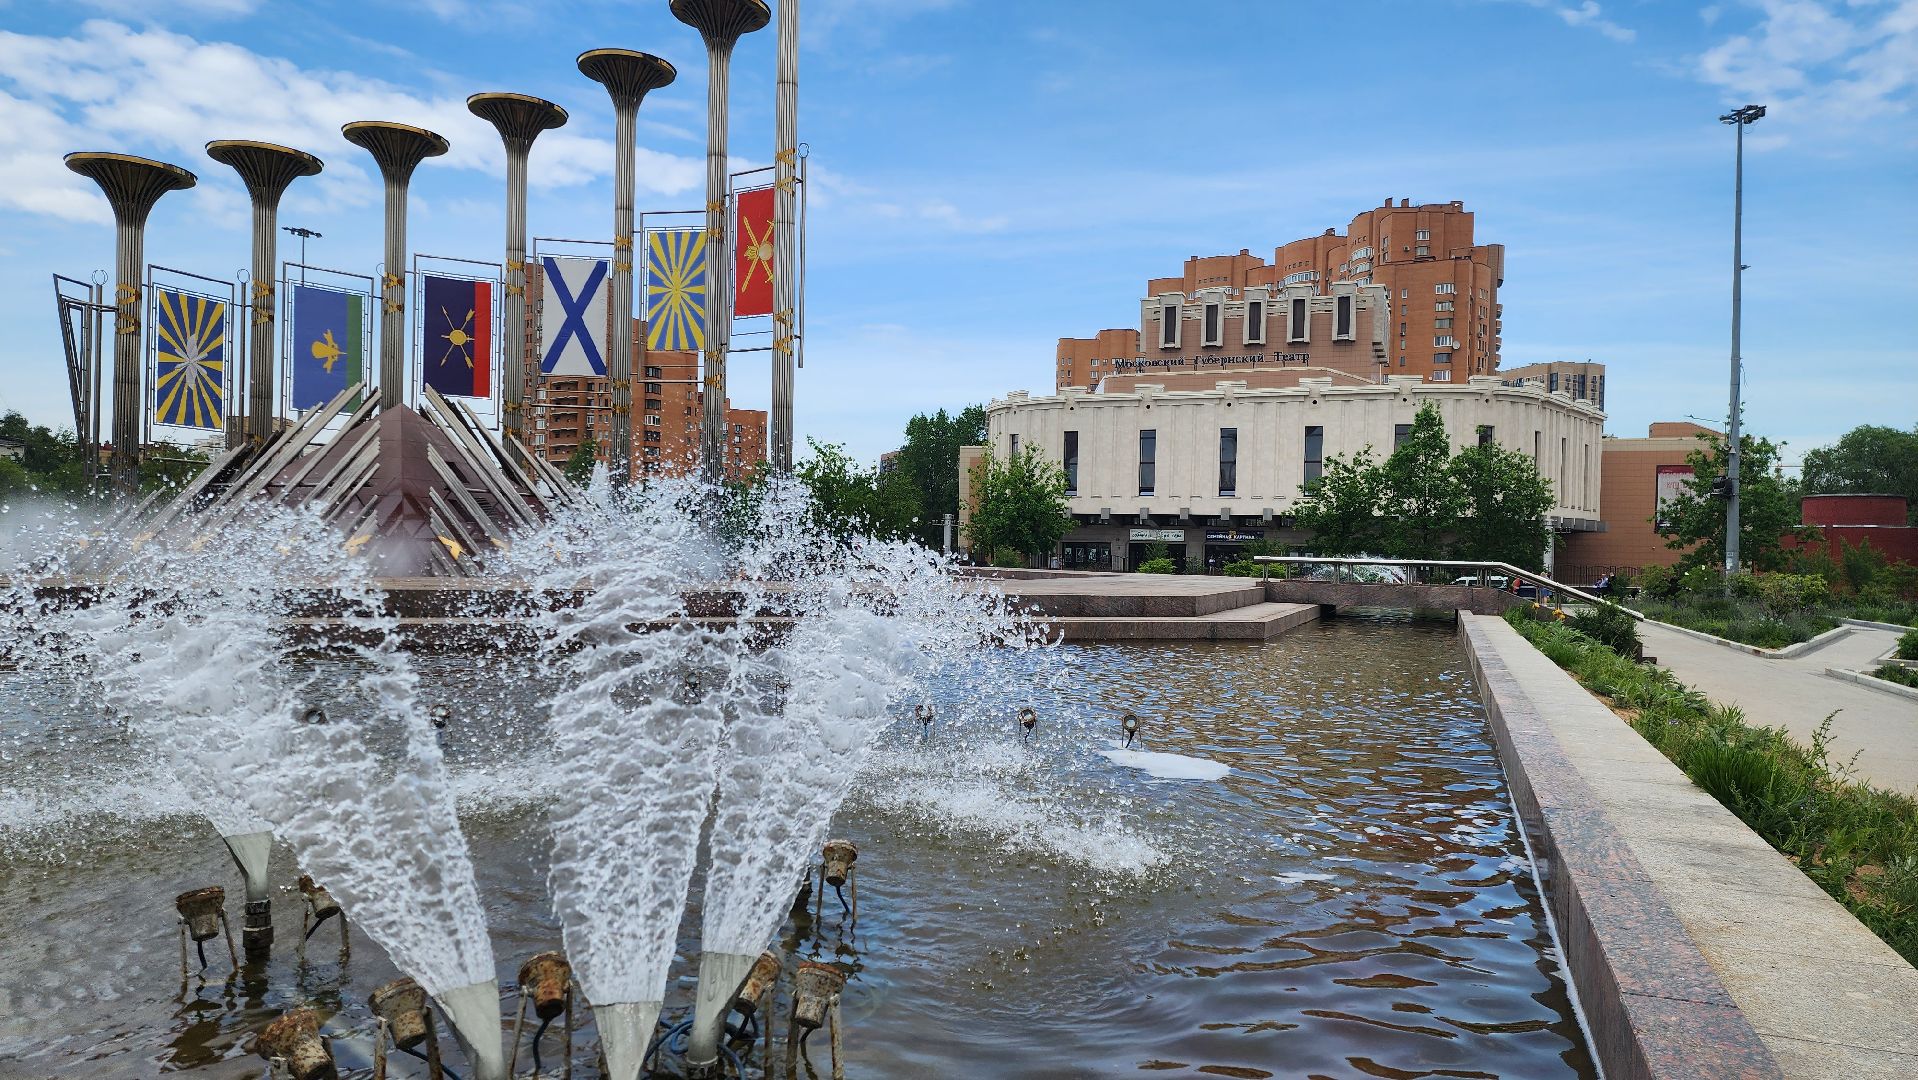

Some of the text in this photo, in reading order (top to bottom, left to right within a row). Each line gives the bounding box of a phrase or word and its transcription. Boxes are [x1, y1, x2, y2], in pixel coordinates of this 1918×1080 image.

[1114, 351, 1310, 369] Московский Губернский Театр
